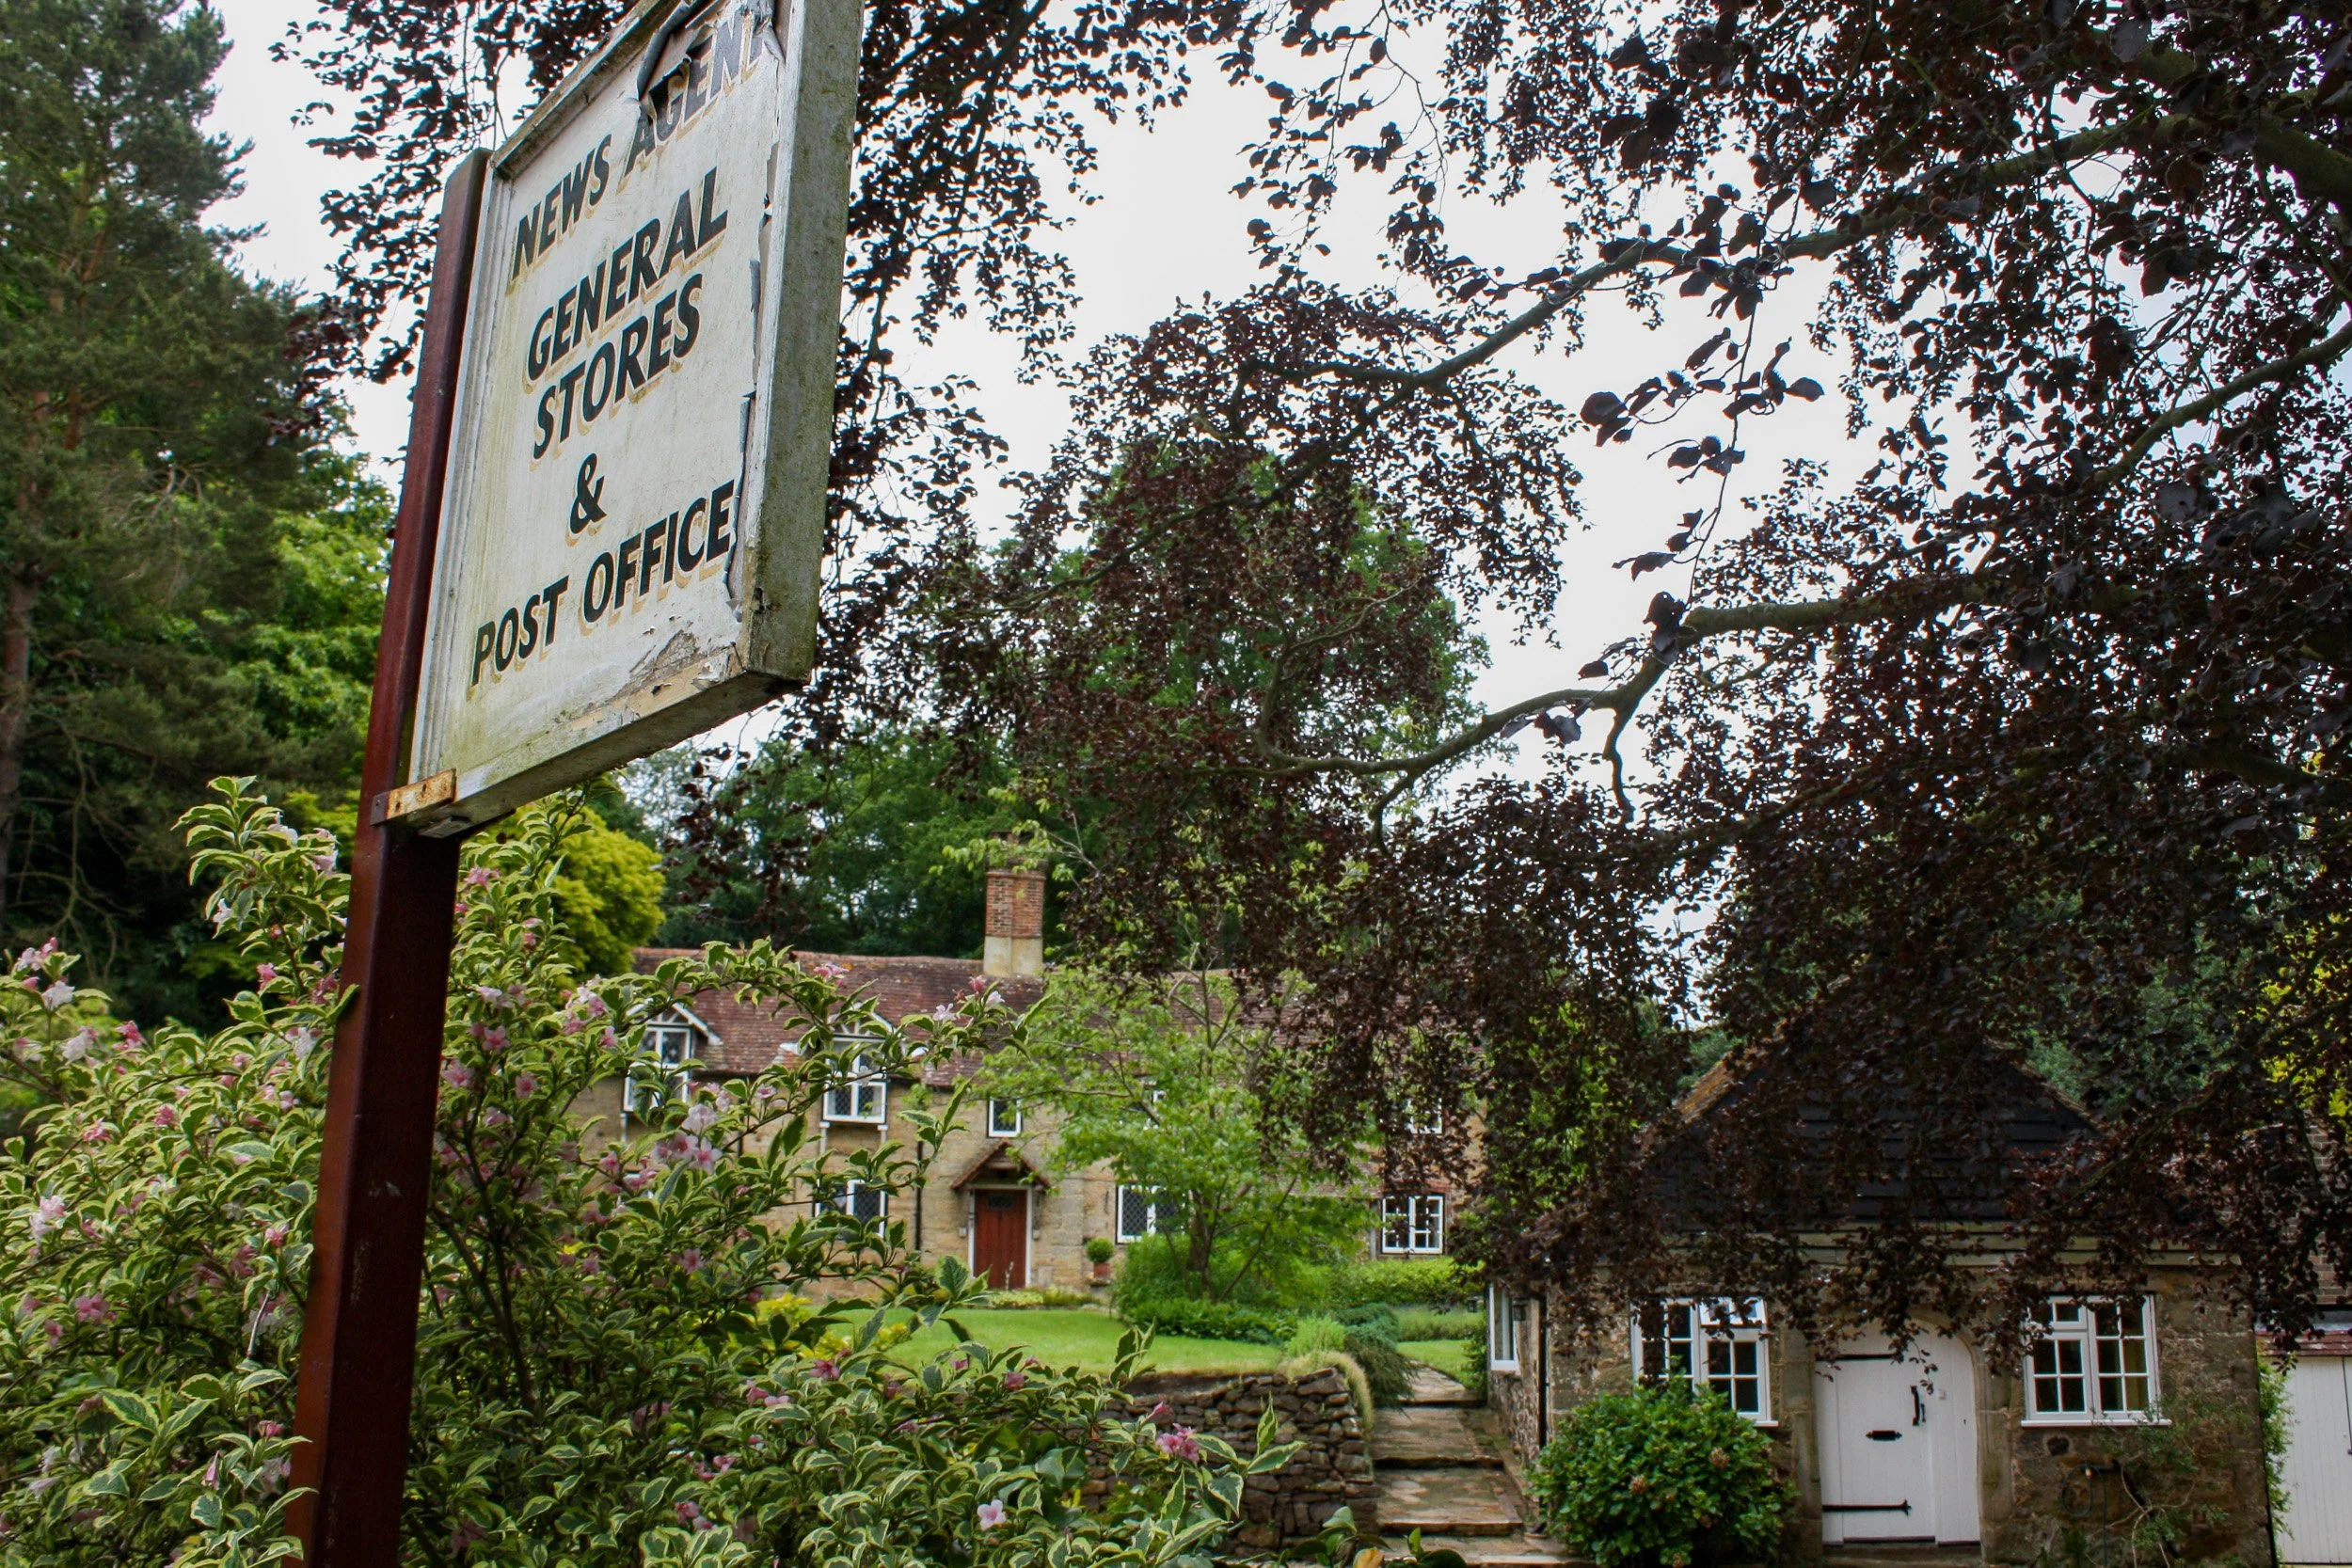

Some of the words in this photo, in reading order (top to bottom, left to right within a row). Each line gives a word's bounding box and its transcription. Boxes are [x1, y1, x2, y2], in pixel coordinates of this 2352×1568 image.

[512, 134, 612, 281] NEWS
[625, 8, 764, 178] AGEN
[529, 166, 728, 381] GENERAL
[533, 273, 702, 460] STORES
[472, 575, 569, 687] POST
[583, 479, 735, 623] OFFICE
[569, 452, 607, 534] &
